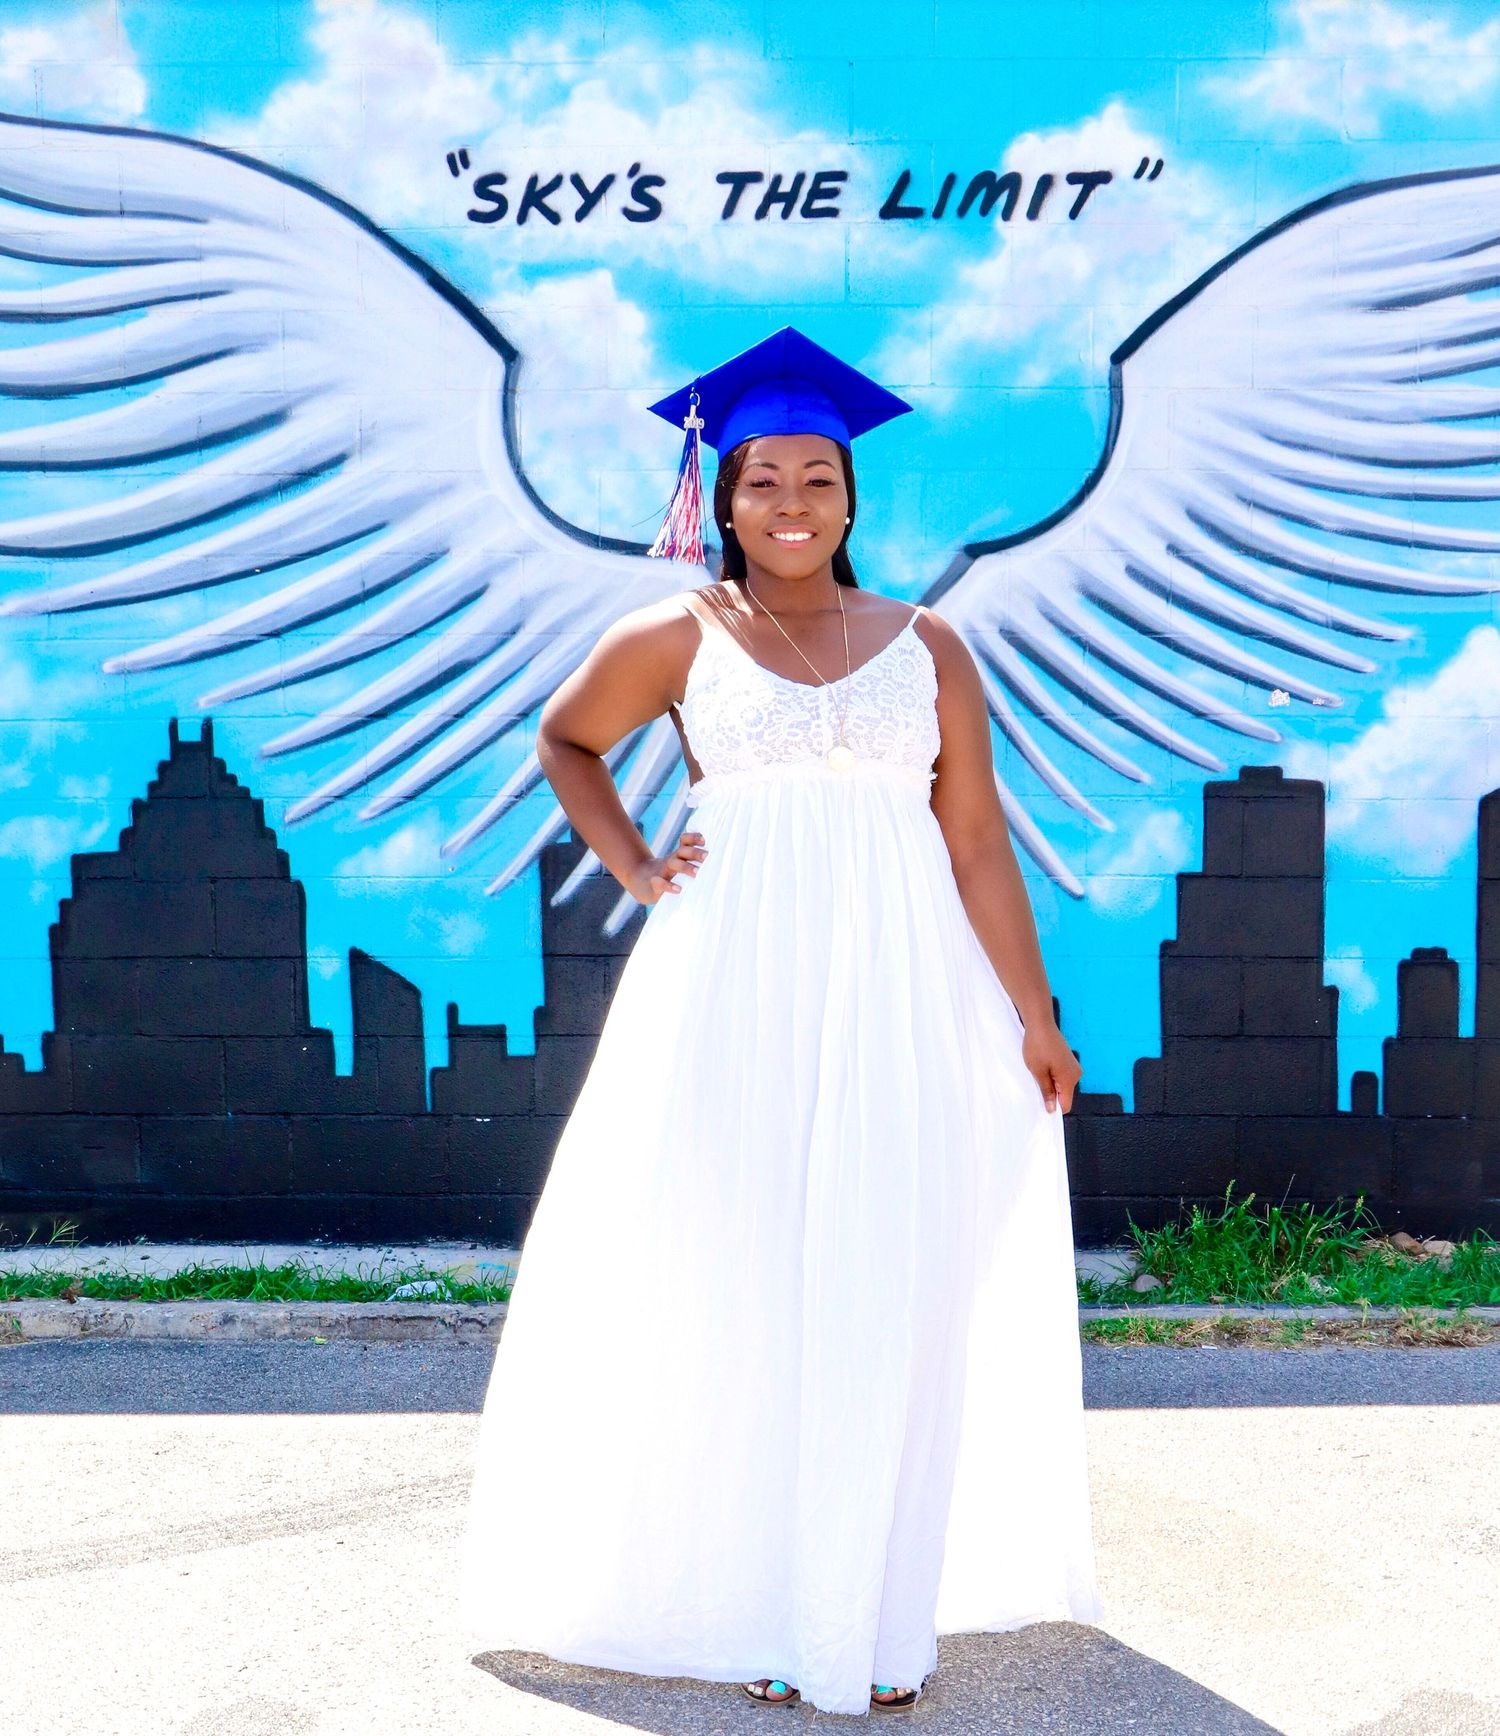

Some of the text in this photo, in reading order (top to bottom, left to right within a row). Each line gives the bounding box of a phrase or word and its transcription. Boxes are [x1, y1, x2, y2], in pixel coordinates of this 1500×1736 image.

[446, 148, 1166, 225] "SKY'S THE LIMIT"
